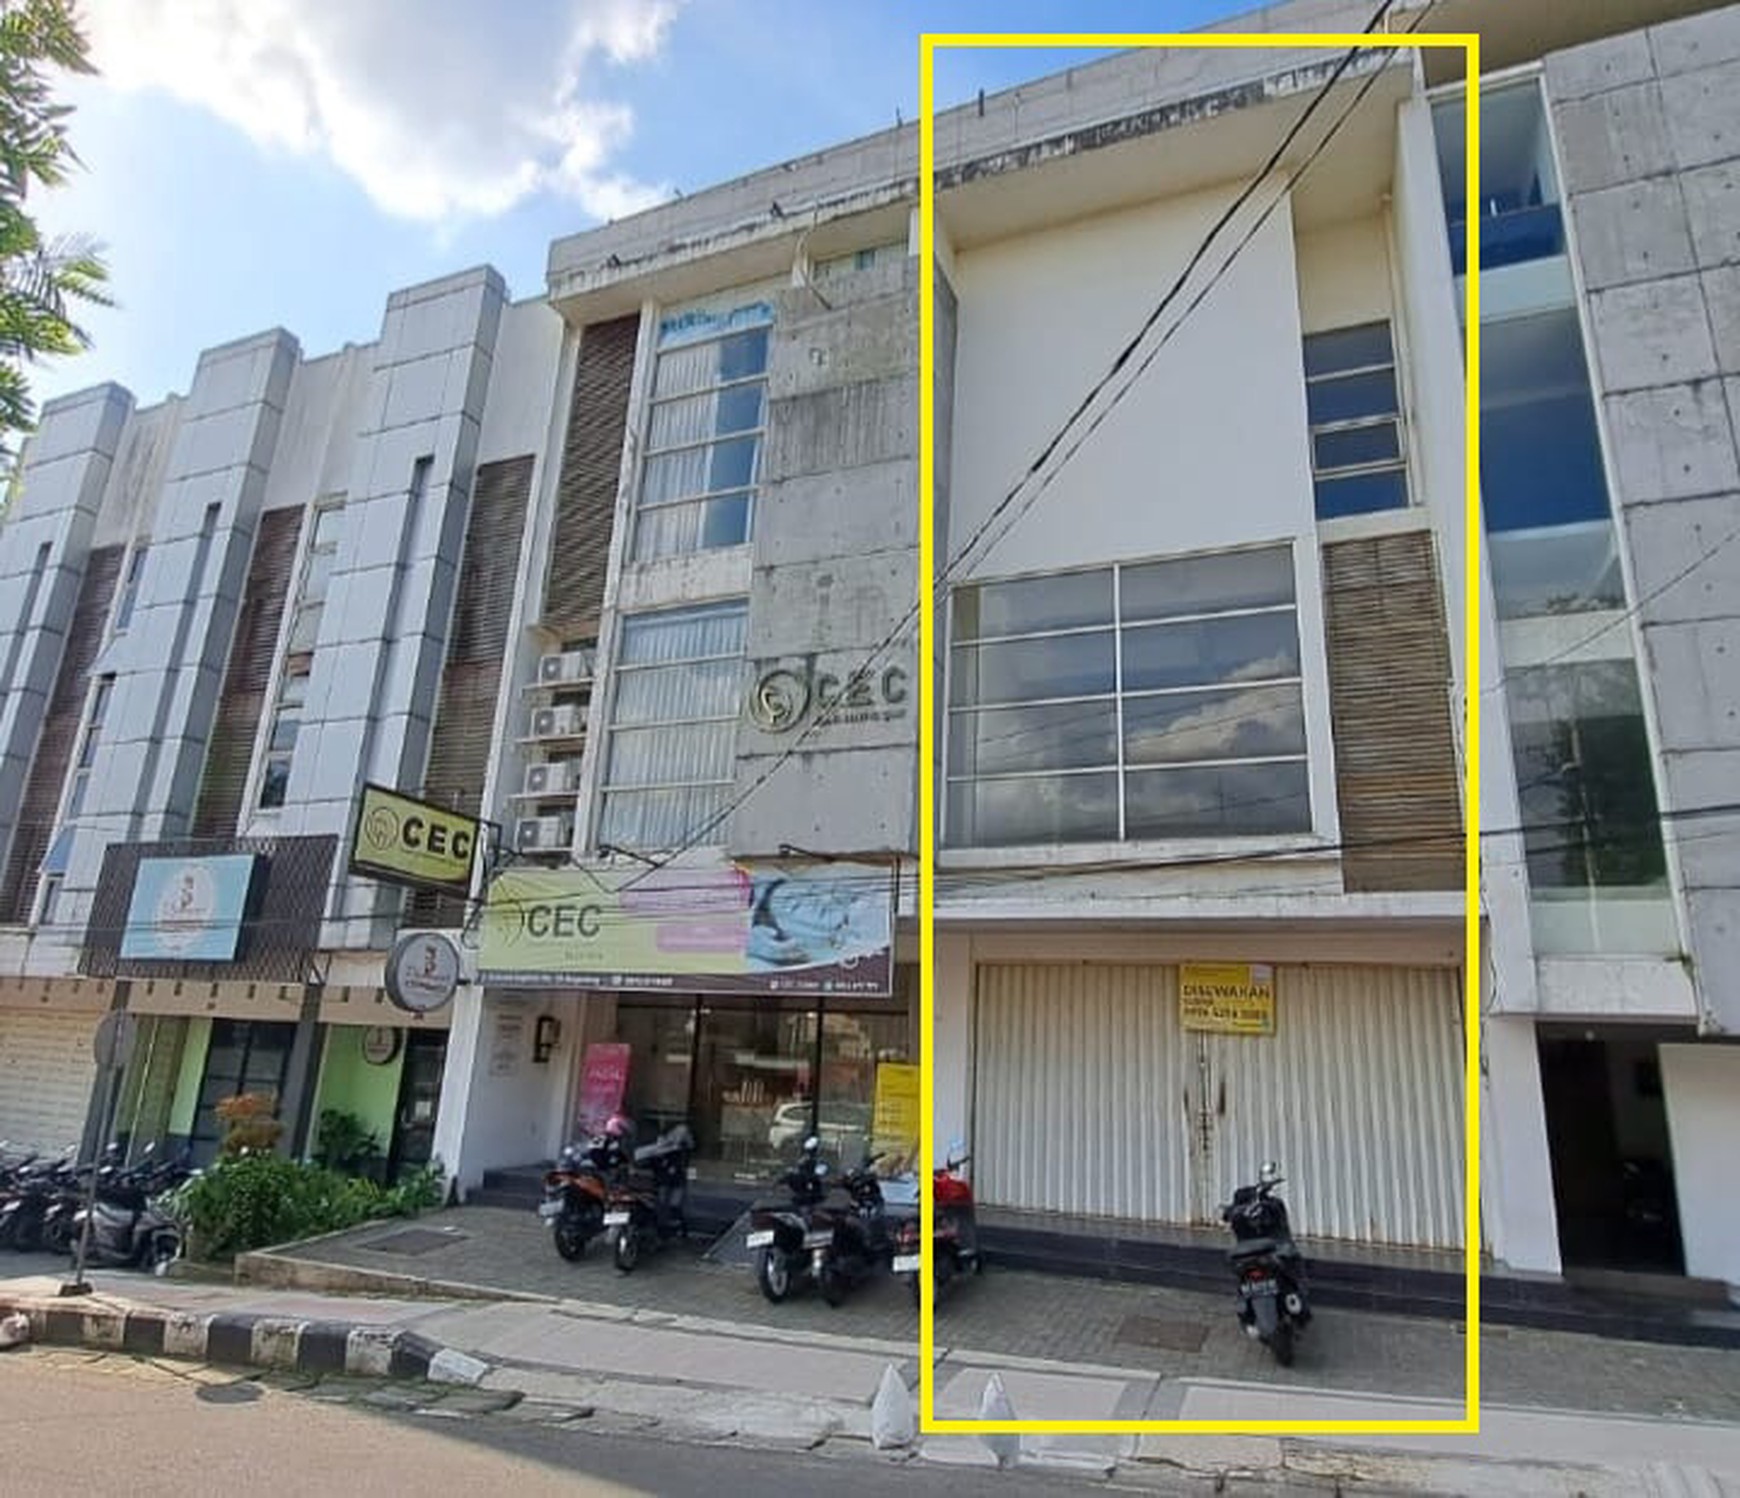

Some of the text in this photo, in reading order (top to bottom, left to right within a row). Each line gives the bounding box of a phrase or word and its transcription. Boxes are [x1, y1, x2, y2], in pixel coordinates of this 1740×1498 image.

[817, 665, 907, 708] CEC
[402, 816, 470, 860] CEC
[527, 904, 602, 938] CEC
